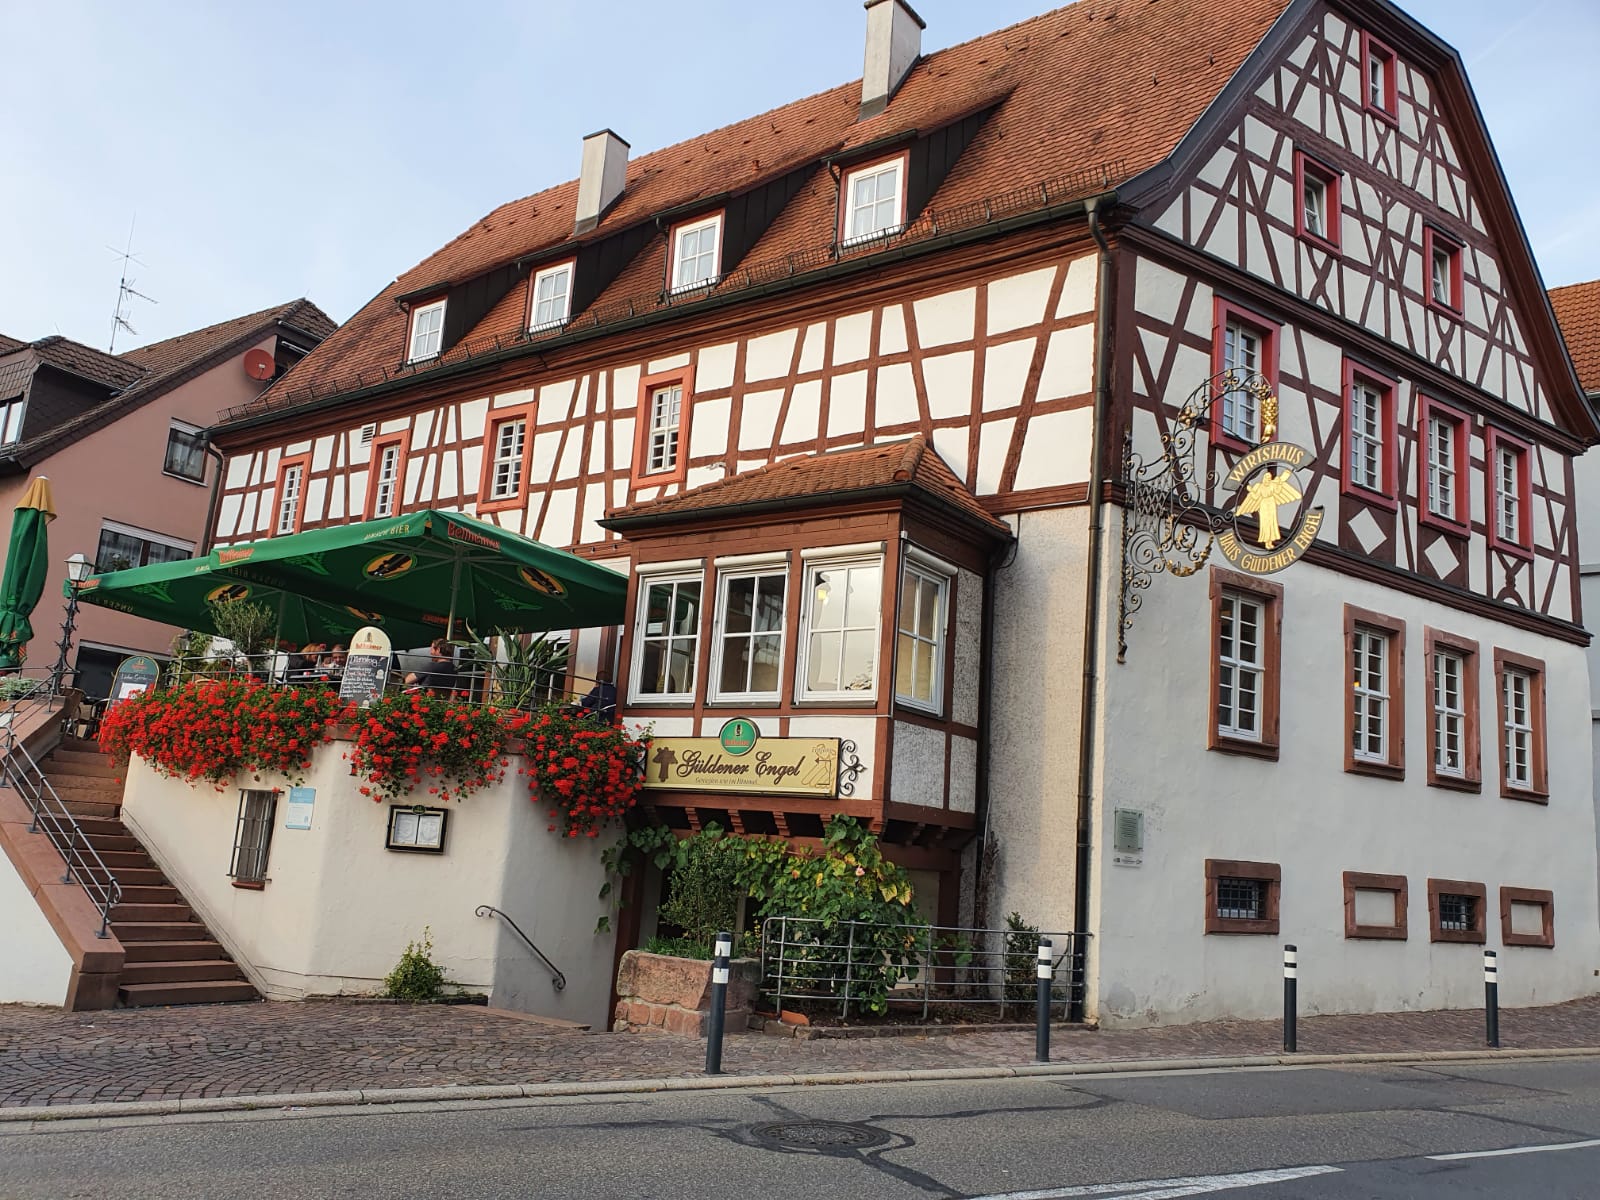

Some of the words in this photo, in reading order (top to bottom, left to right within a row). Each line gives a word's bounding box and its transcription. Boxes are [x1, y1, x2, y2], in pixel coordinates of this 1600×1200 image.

[1228, 443, 1305, 482] WIRTSHAUS
[390, 524, 409, 535] BIER
[1219, 532, 1242, 561] HAUS
[1241, 547, 1297, 572] GÜLDENER
[1294, 512, 1322, 550] ENGEL
[676, 749, 750, 778] Güldener
[755, 749, 806, 785] Engel
